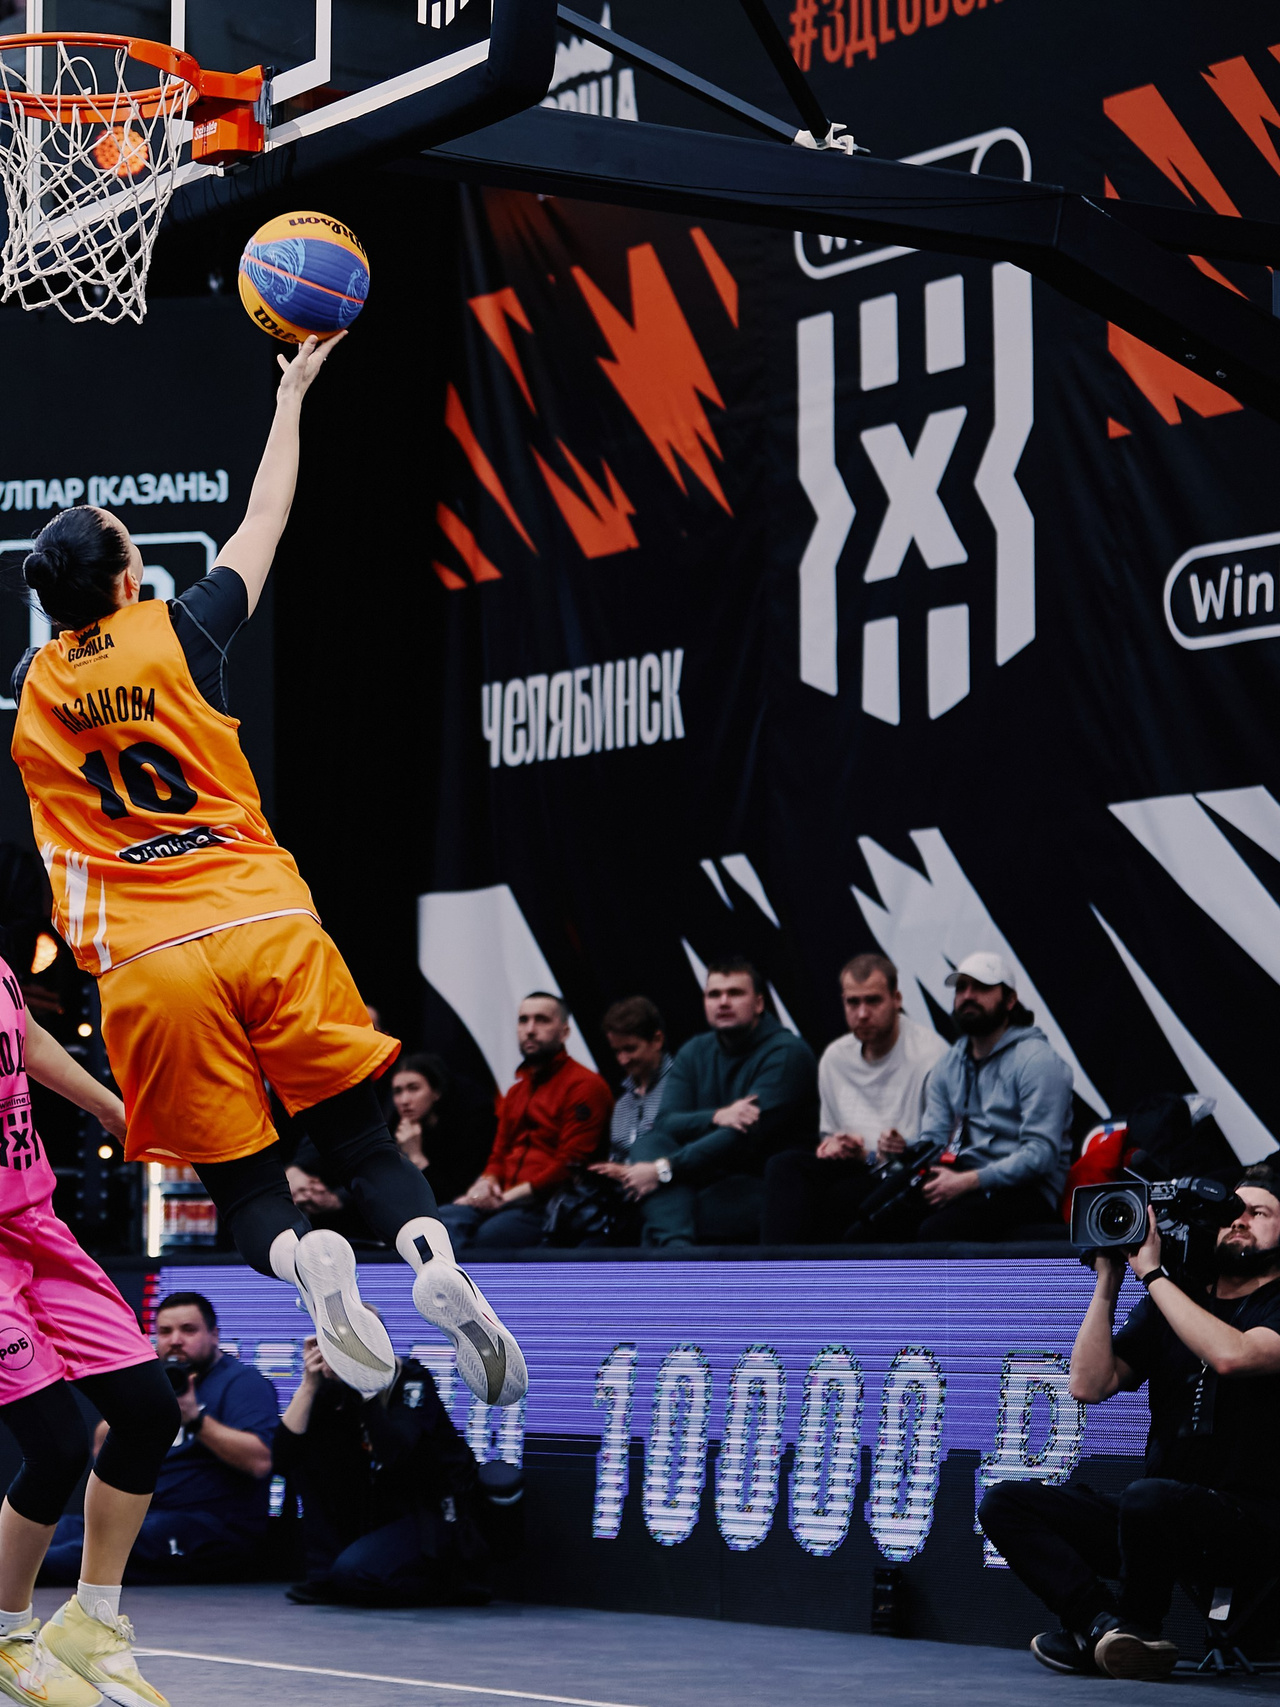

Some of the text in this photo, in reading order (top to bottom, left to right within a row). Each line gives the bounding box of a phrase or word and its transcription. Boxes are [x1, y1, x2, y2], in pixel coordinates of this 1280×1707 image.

[68, 632, 115, 663] GORILLA
[51, 685, 156, 735] КАЗАКОВА
[78, 741, 199, 820] 10
[592, 1342, 947, 1562] 10000
